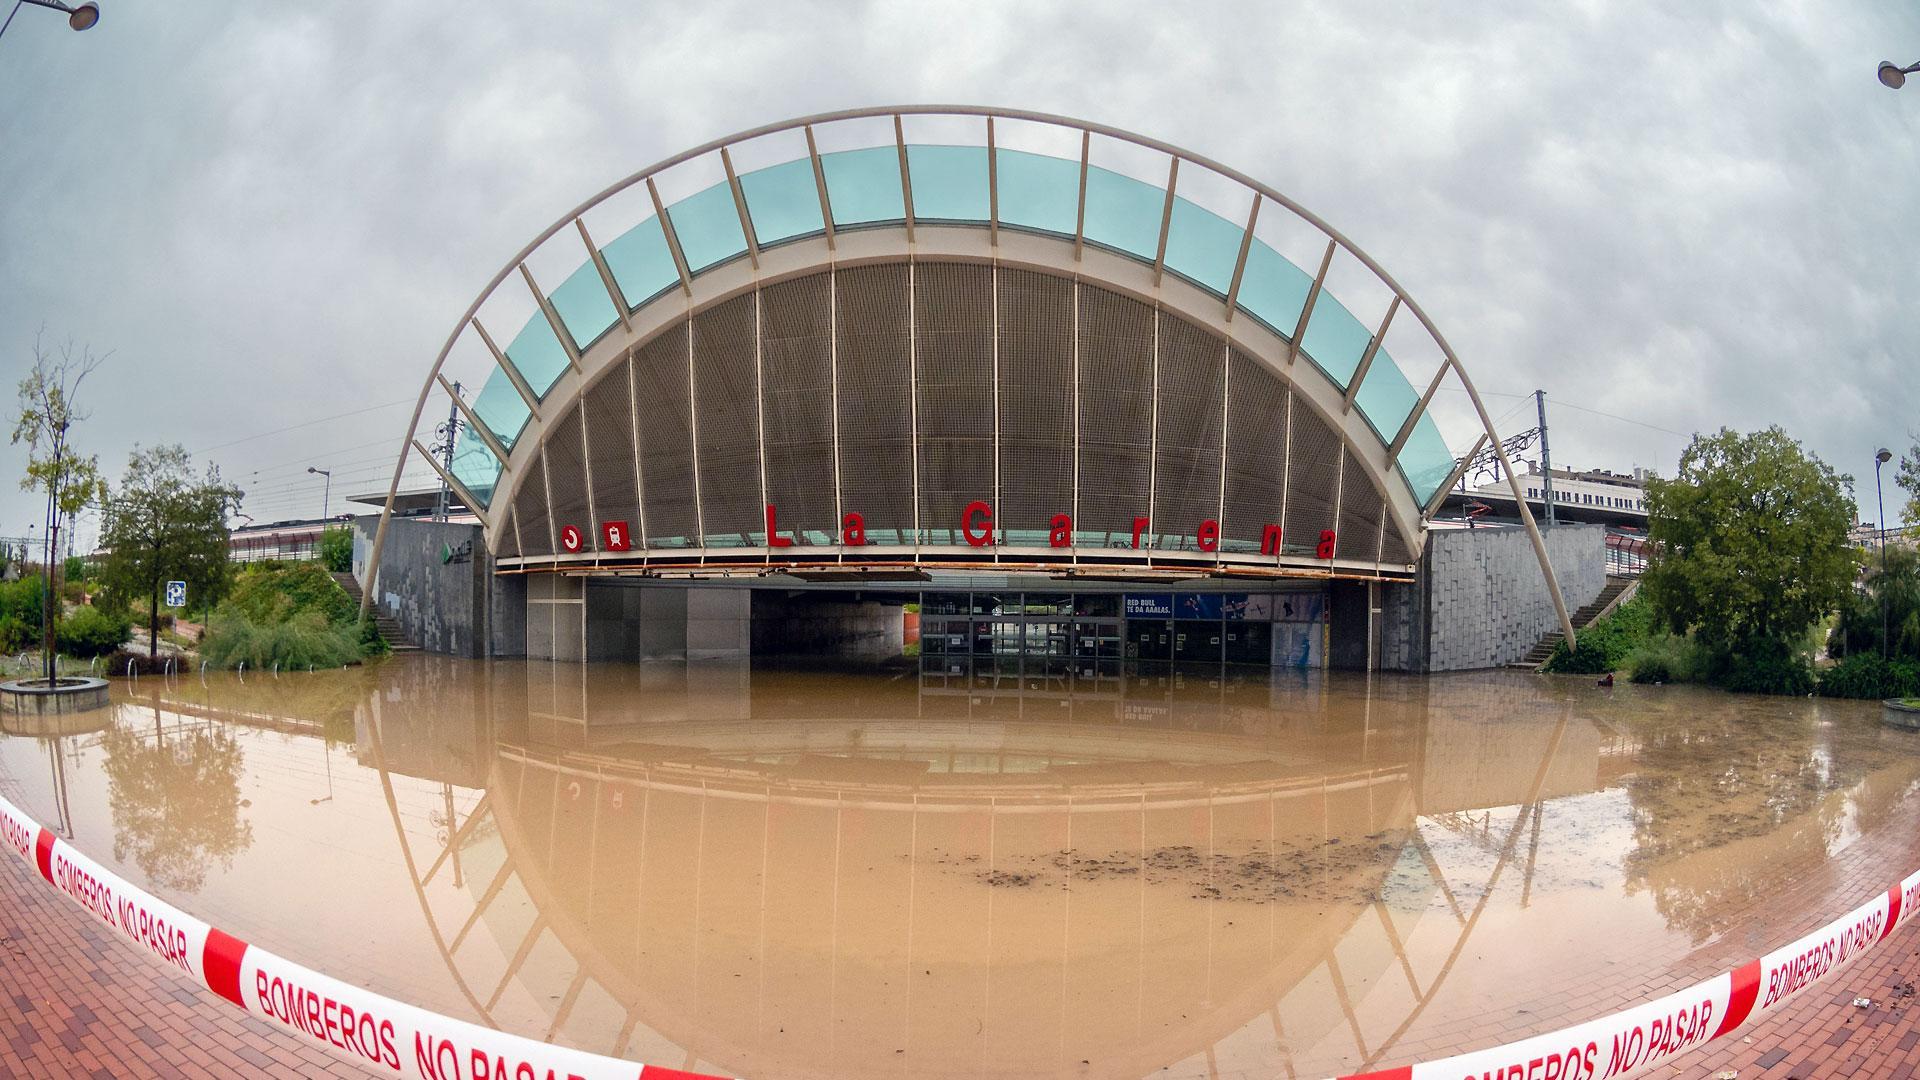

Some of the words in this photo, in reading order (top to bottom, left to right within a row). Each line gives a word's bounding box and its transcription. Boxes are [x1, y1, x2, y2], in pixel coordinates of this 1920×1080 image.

[767, 503, 865, 547] La
[961, 500, 1337, 560] Garena
[57, 853, 116, 928] BOMBEROS
[118, 894, 140, 943] NO
[139, 907, 195, 977] PASAR
[1762, 937, 1835, 1009] BOMBEROS
[1833, 927, 1854, 968] NO
[1849, 909, 1882, 957] PASAR
[256, 968, 401, 1071] BOMBEROS
[414, 1030, 462, 1080] NO
[1602, 1026, 1643, 1080] NO
[1641, 999, 1713, 1066] PASAR
